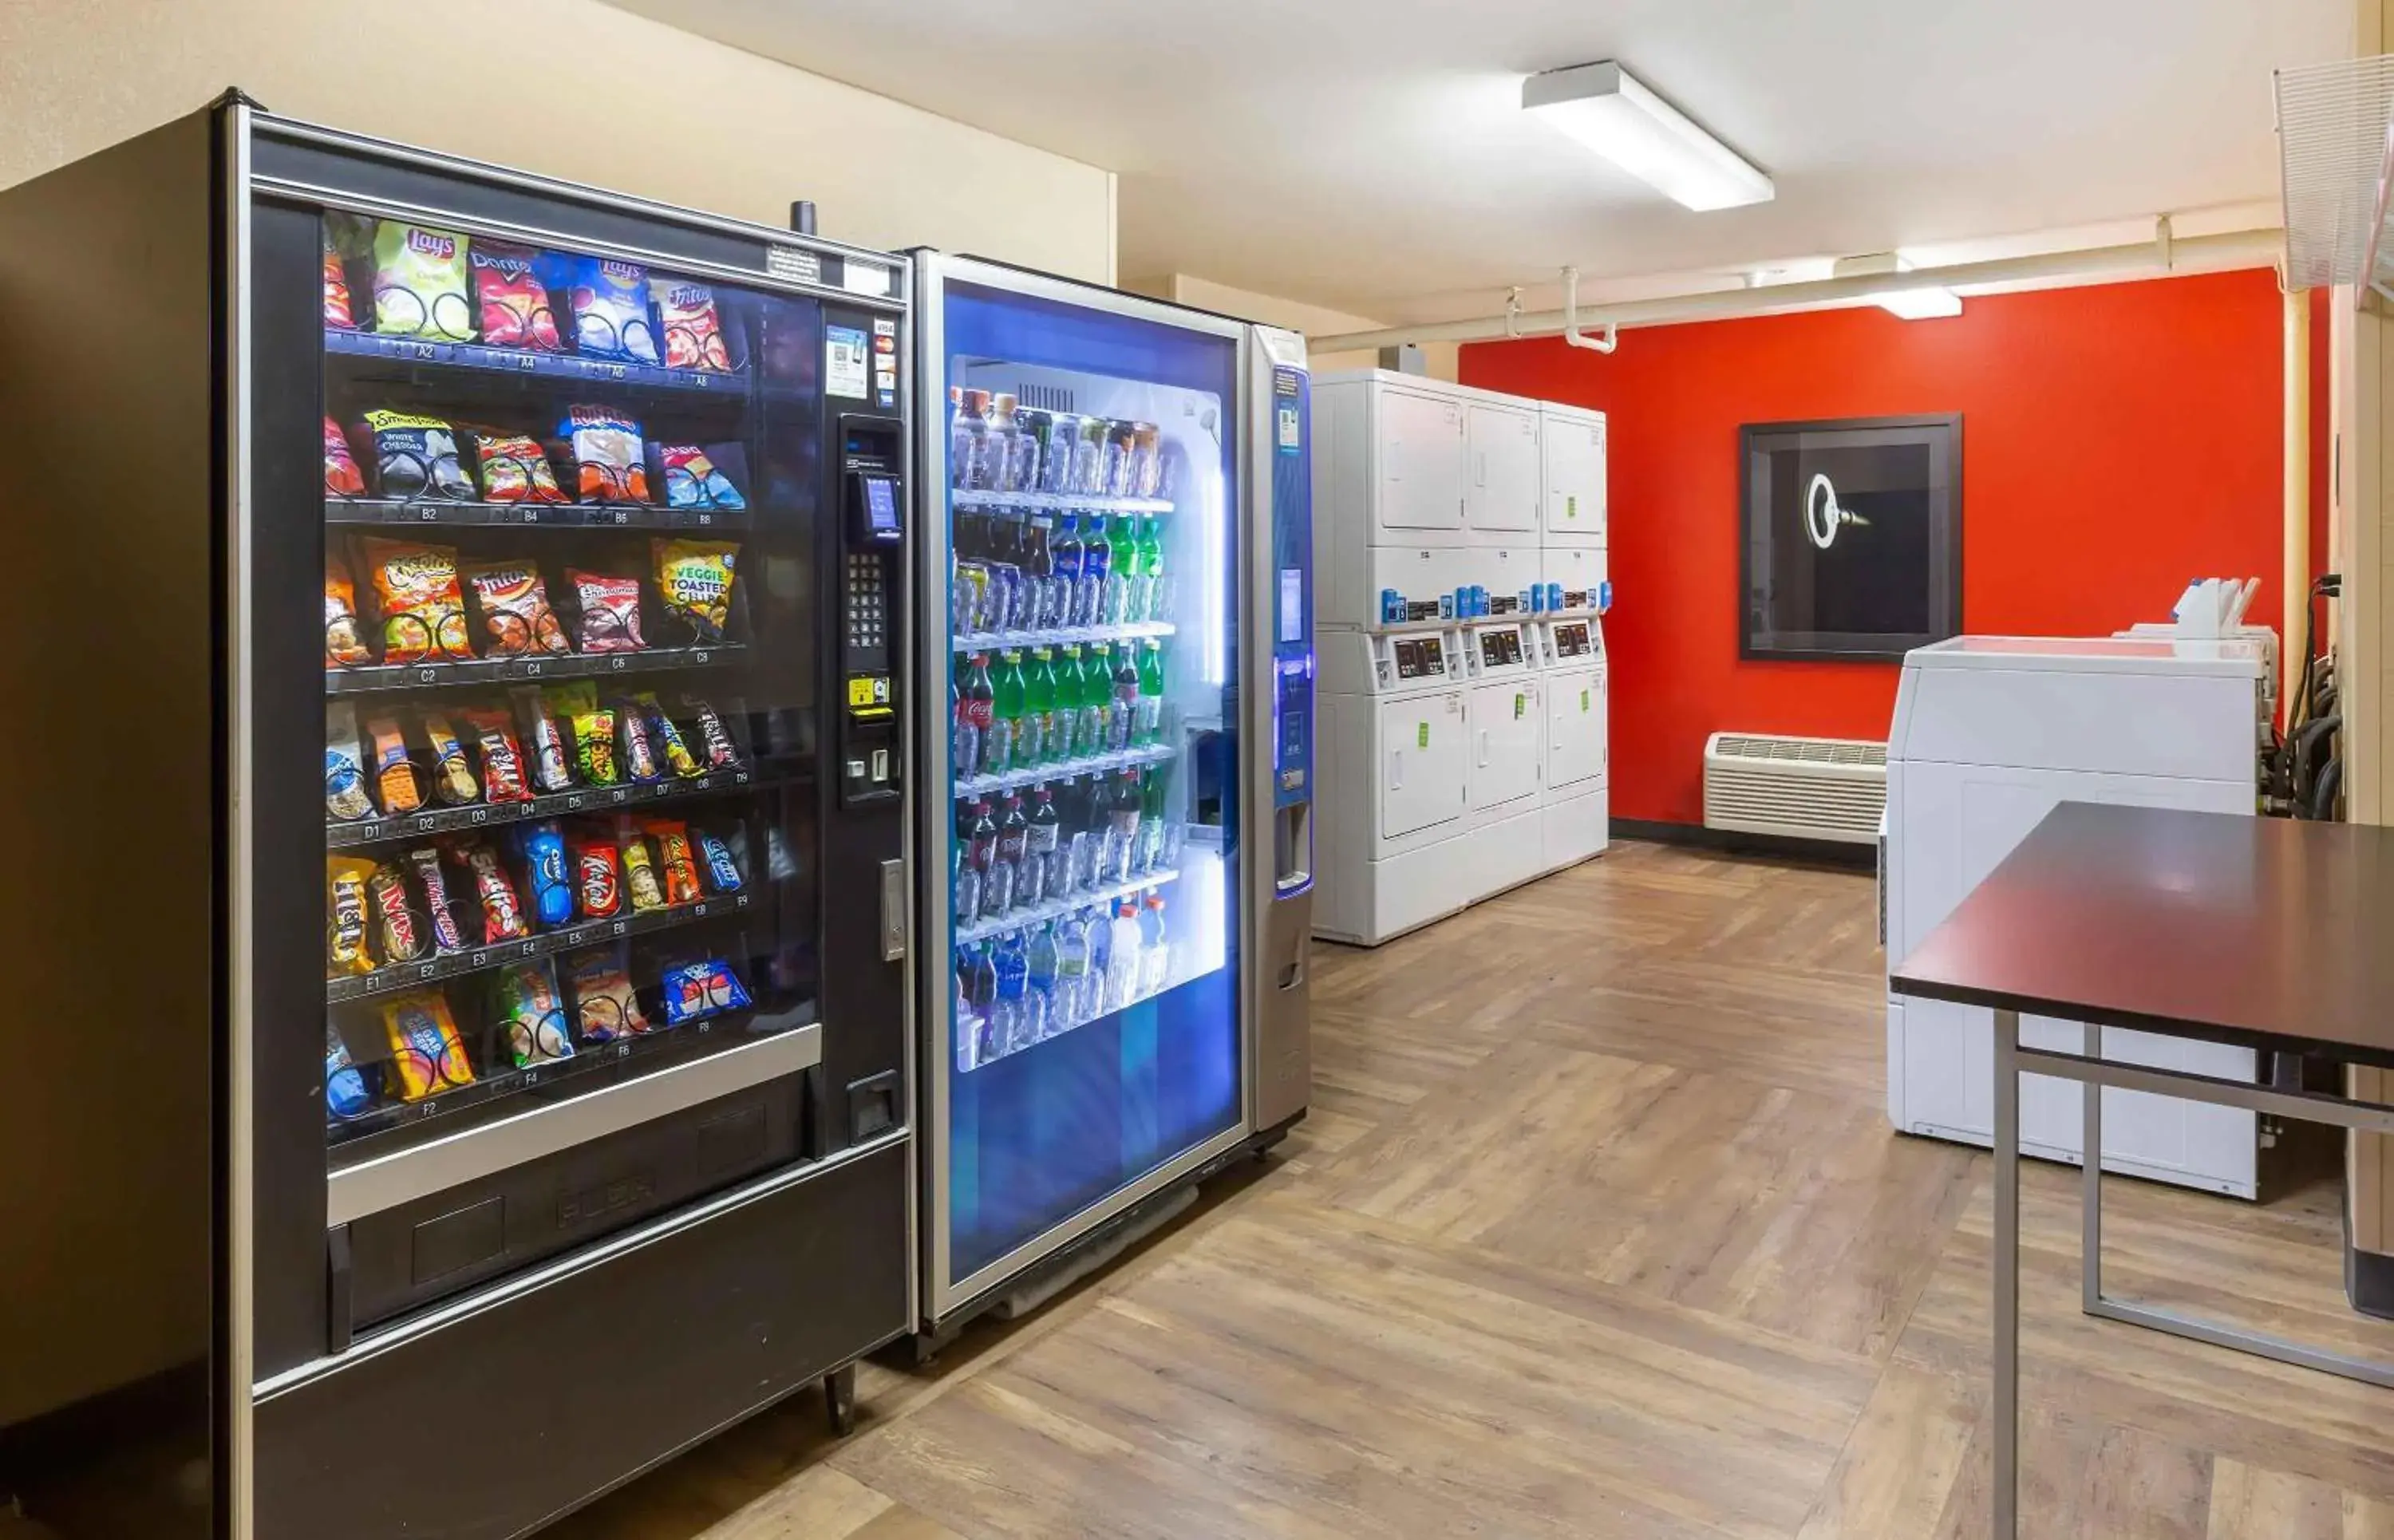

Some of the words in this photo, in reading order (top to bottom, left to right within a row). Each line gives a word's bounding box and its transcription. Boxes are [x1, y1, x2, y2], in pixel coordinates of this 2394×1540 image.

[418, 345, 433, 358] A2
[521, 357, 535, 369] A4
[422, 508, 437, 520] B2
[524, 511, 537, 522] B4
[676, 567, 726, 582] VEGGIE
[670, 578, 729, 594] TOASTED
[676, 591, 721, 603] CHIP
[527, 663, 540, 675] C4
[612, 657, 625, 669] C6
[421, 669, 435, 682] C2
[657, 784, 669, 795] D7
[569, 796, 582, 808] D5
[521, 803, 535, 815] D4
[472, 810, 486, 822] D3
[419, 817, 434, 831] D2
[365, 824, 379, 838] D1
[569, 933, 582, 943] E5
[523, 943, 535, 954] E4
[473, 954, 486, 965] E3
[421, 965, 435, 977] E2
[366, 977, 380, 989] E1
[618, 1045, 630, 1056] F6
[526, 1073, 537, 1085] F4
[423, 1102, 437, 1116] F2
